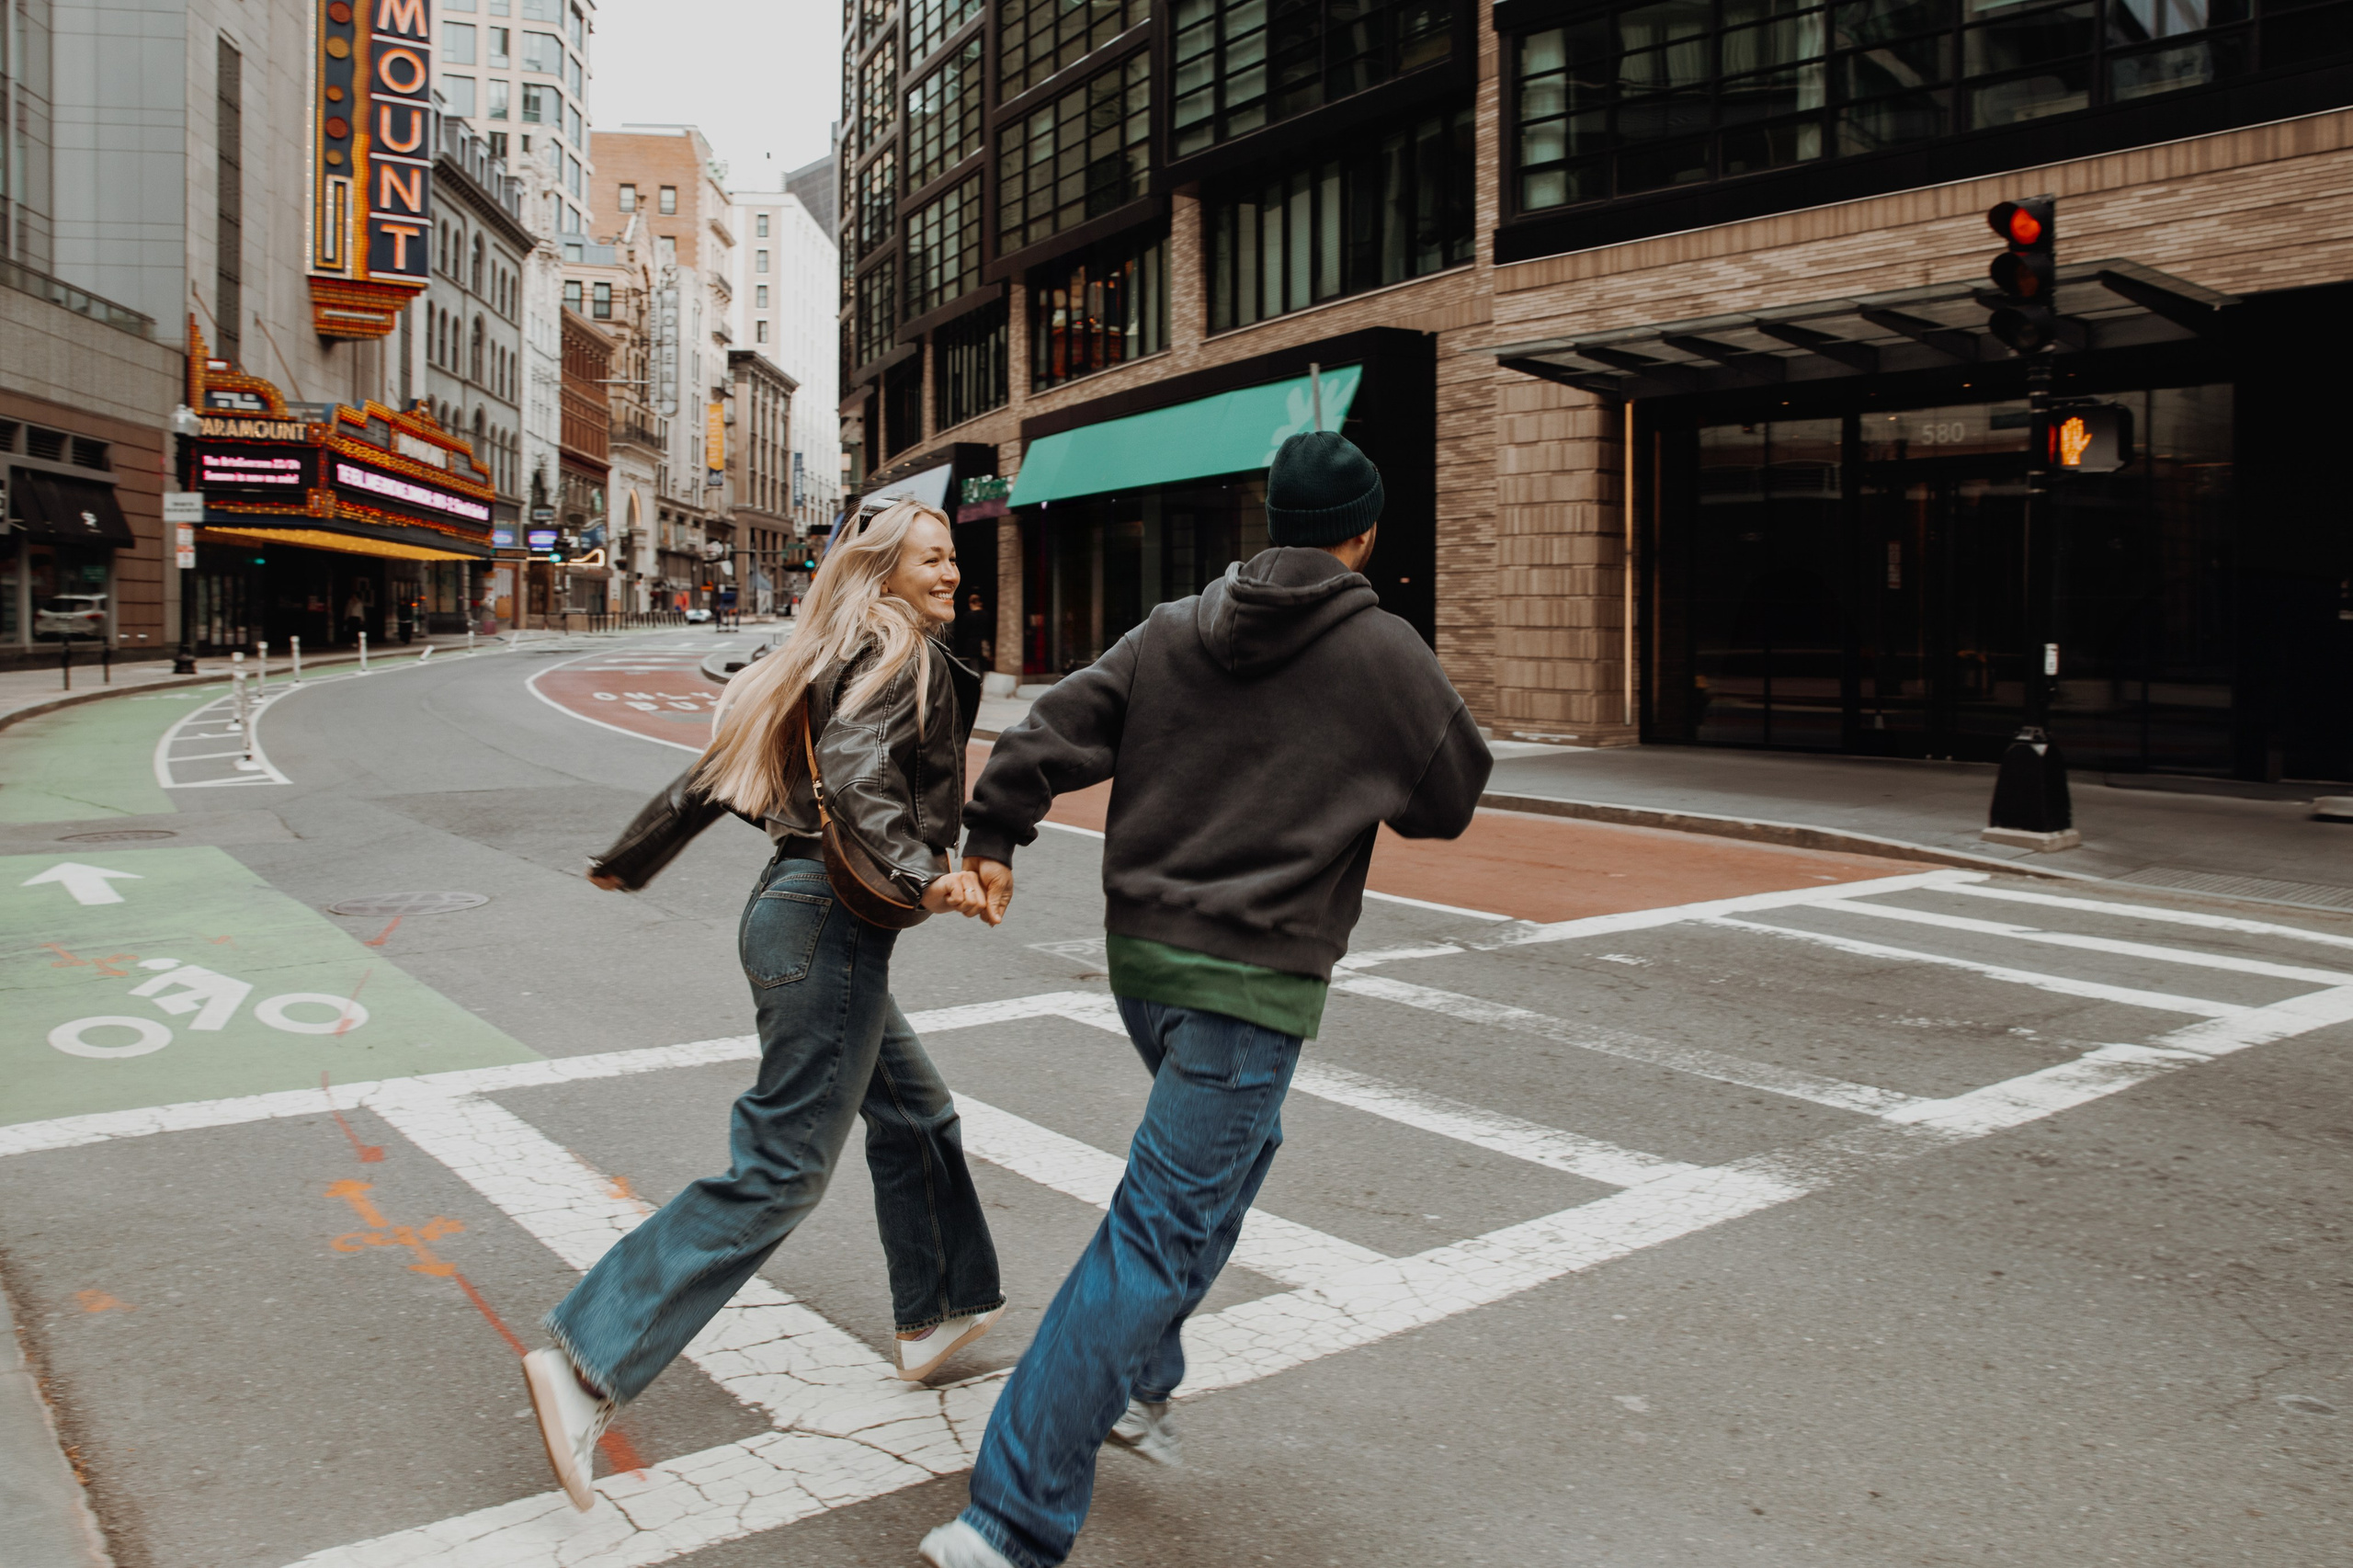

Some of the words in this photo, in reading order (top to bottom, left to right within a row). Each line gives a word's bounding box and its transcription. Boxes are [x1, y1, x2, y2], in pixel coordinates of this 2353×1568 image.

[376, 0, 428, 270] MOUNT
[1921, 422, 1965, 445] 580
[592, 691, 723, 701] ONLY
